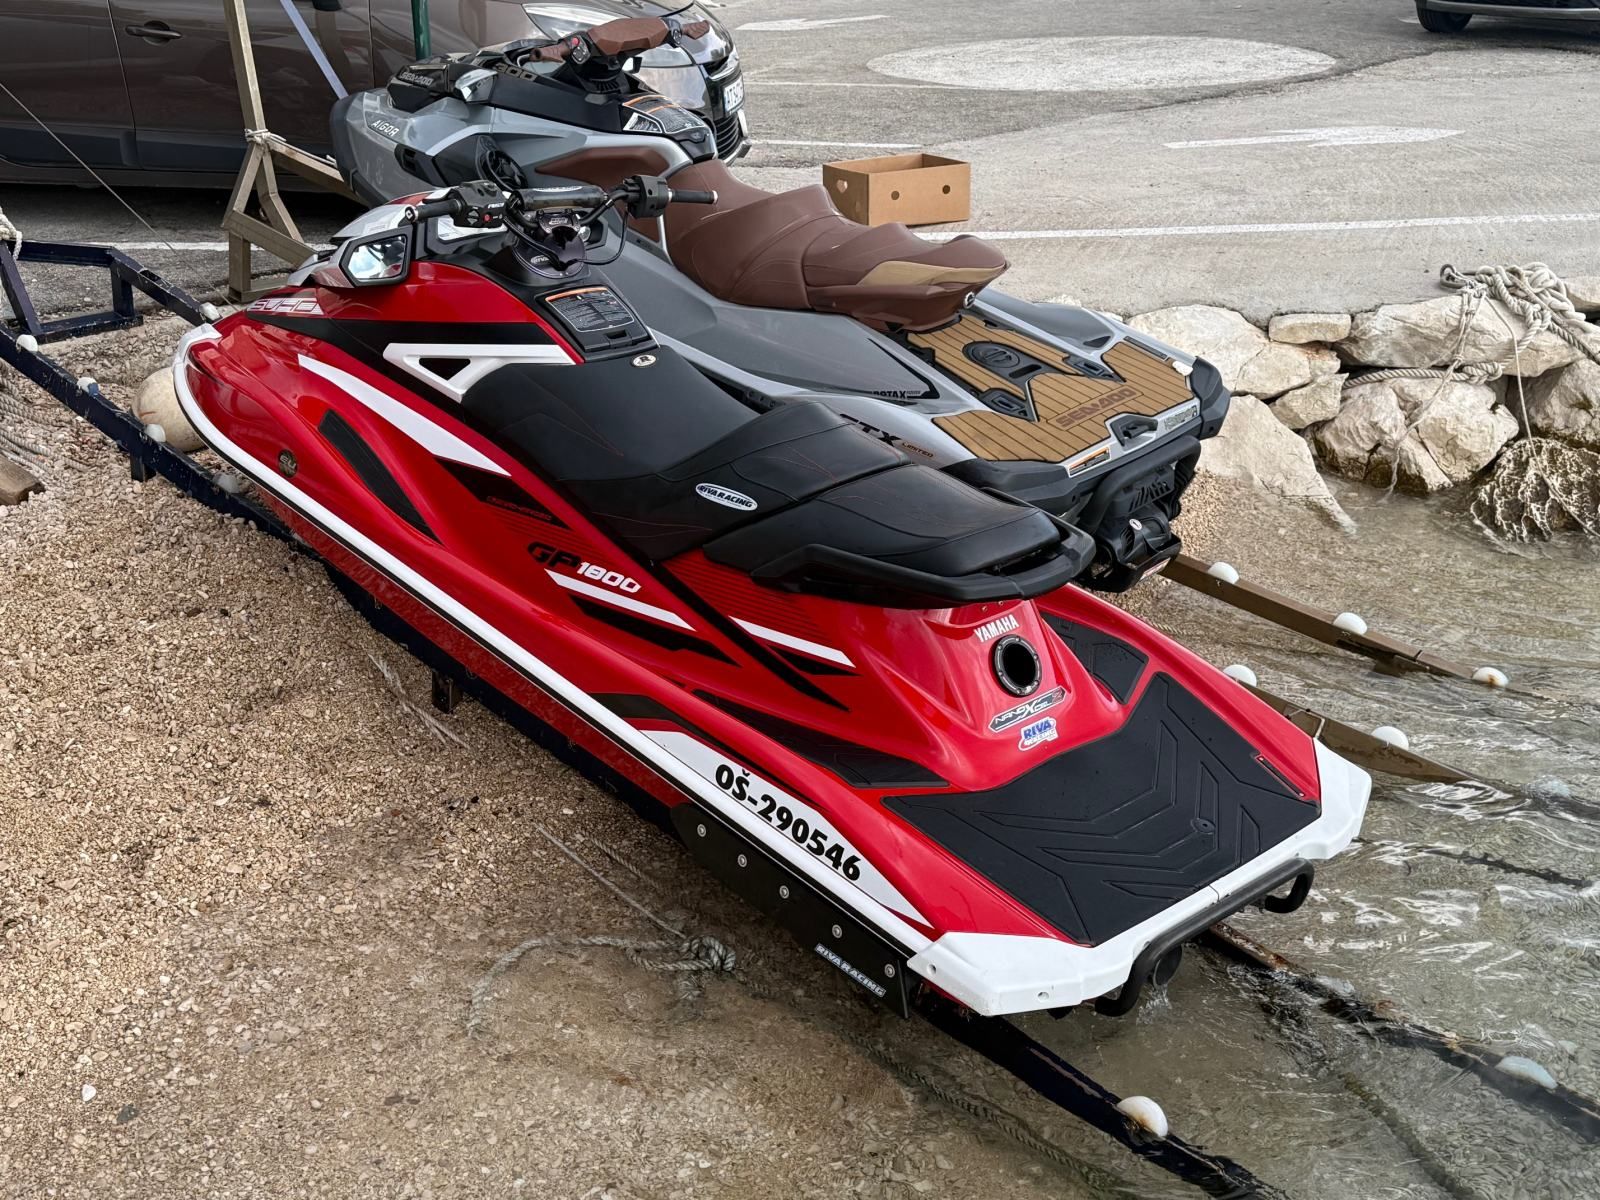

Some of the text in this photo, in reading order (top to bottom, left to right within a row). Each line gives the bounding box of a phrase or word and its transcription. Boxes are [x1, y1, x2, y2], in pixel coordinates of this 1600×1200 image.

[840, 413, 902, 448] TX
[974, 614, 1020, 643] YAMAHA
[1023, 719, 1052, 740] RIVA
[715, 764, 861, 881] OŠ-290546
